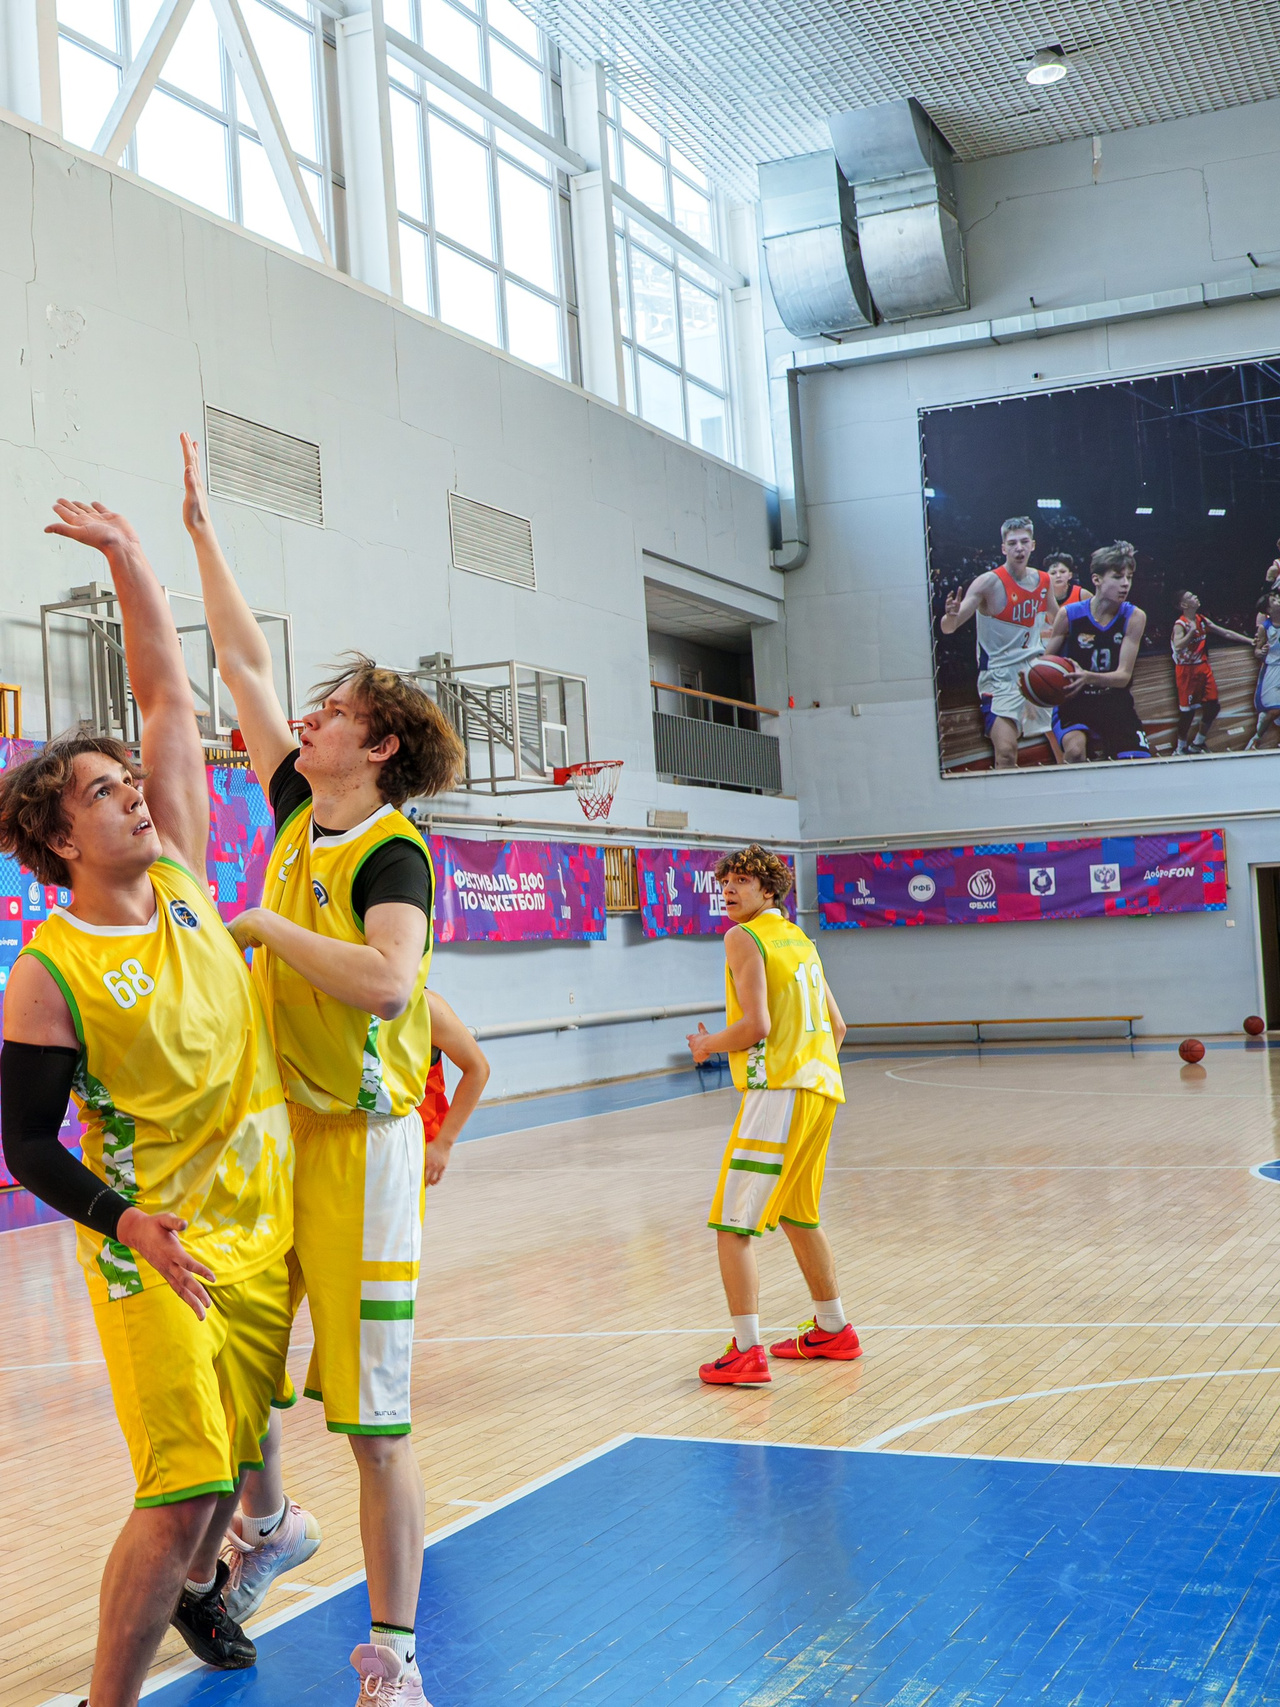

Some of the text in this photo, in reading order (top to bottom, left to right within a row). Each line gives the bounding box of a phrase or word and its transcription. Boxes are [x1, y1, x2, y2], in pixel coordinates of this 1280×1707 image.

[1013, 599, 1042, 621] ЦСК
[453, 869, 545, 892] ФЕСТИВАЛЬ ДФО
[913, 884, 931, 892] РФБ
[458, 891, 479, 910] ПО
[479, 892, 546, 912] БАСКЕТБОЛУ
[852, 896, 875, 906] LIGA PRO
[969, 901, 996, 909] ФБХК
[102, 957, 155, 1009] 68
[794, 962, 832, 1034] 12
